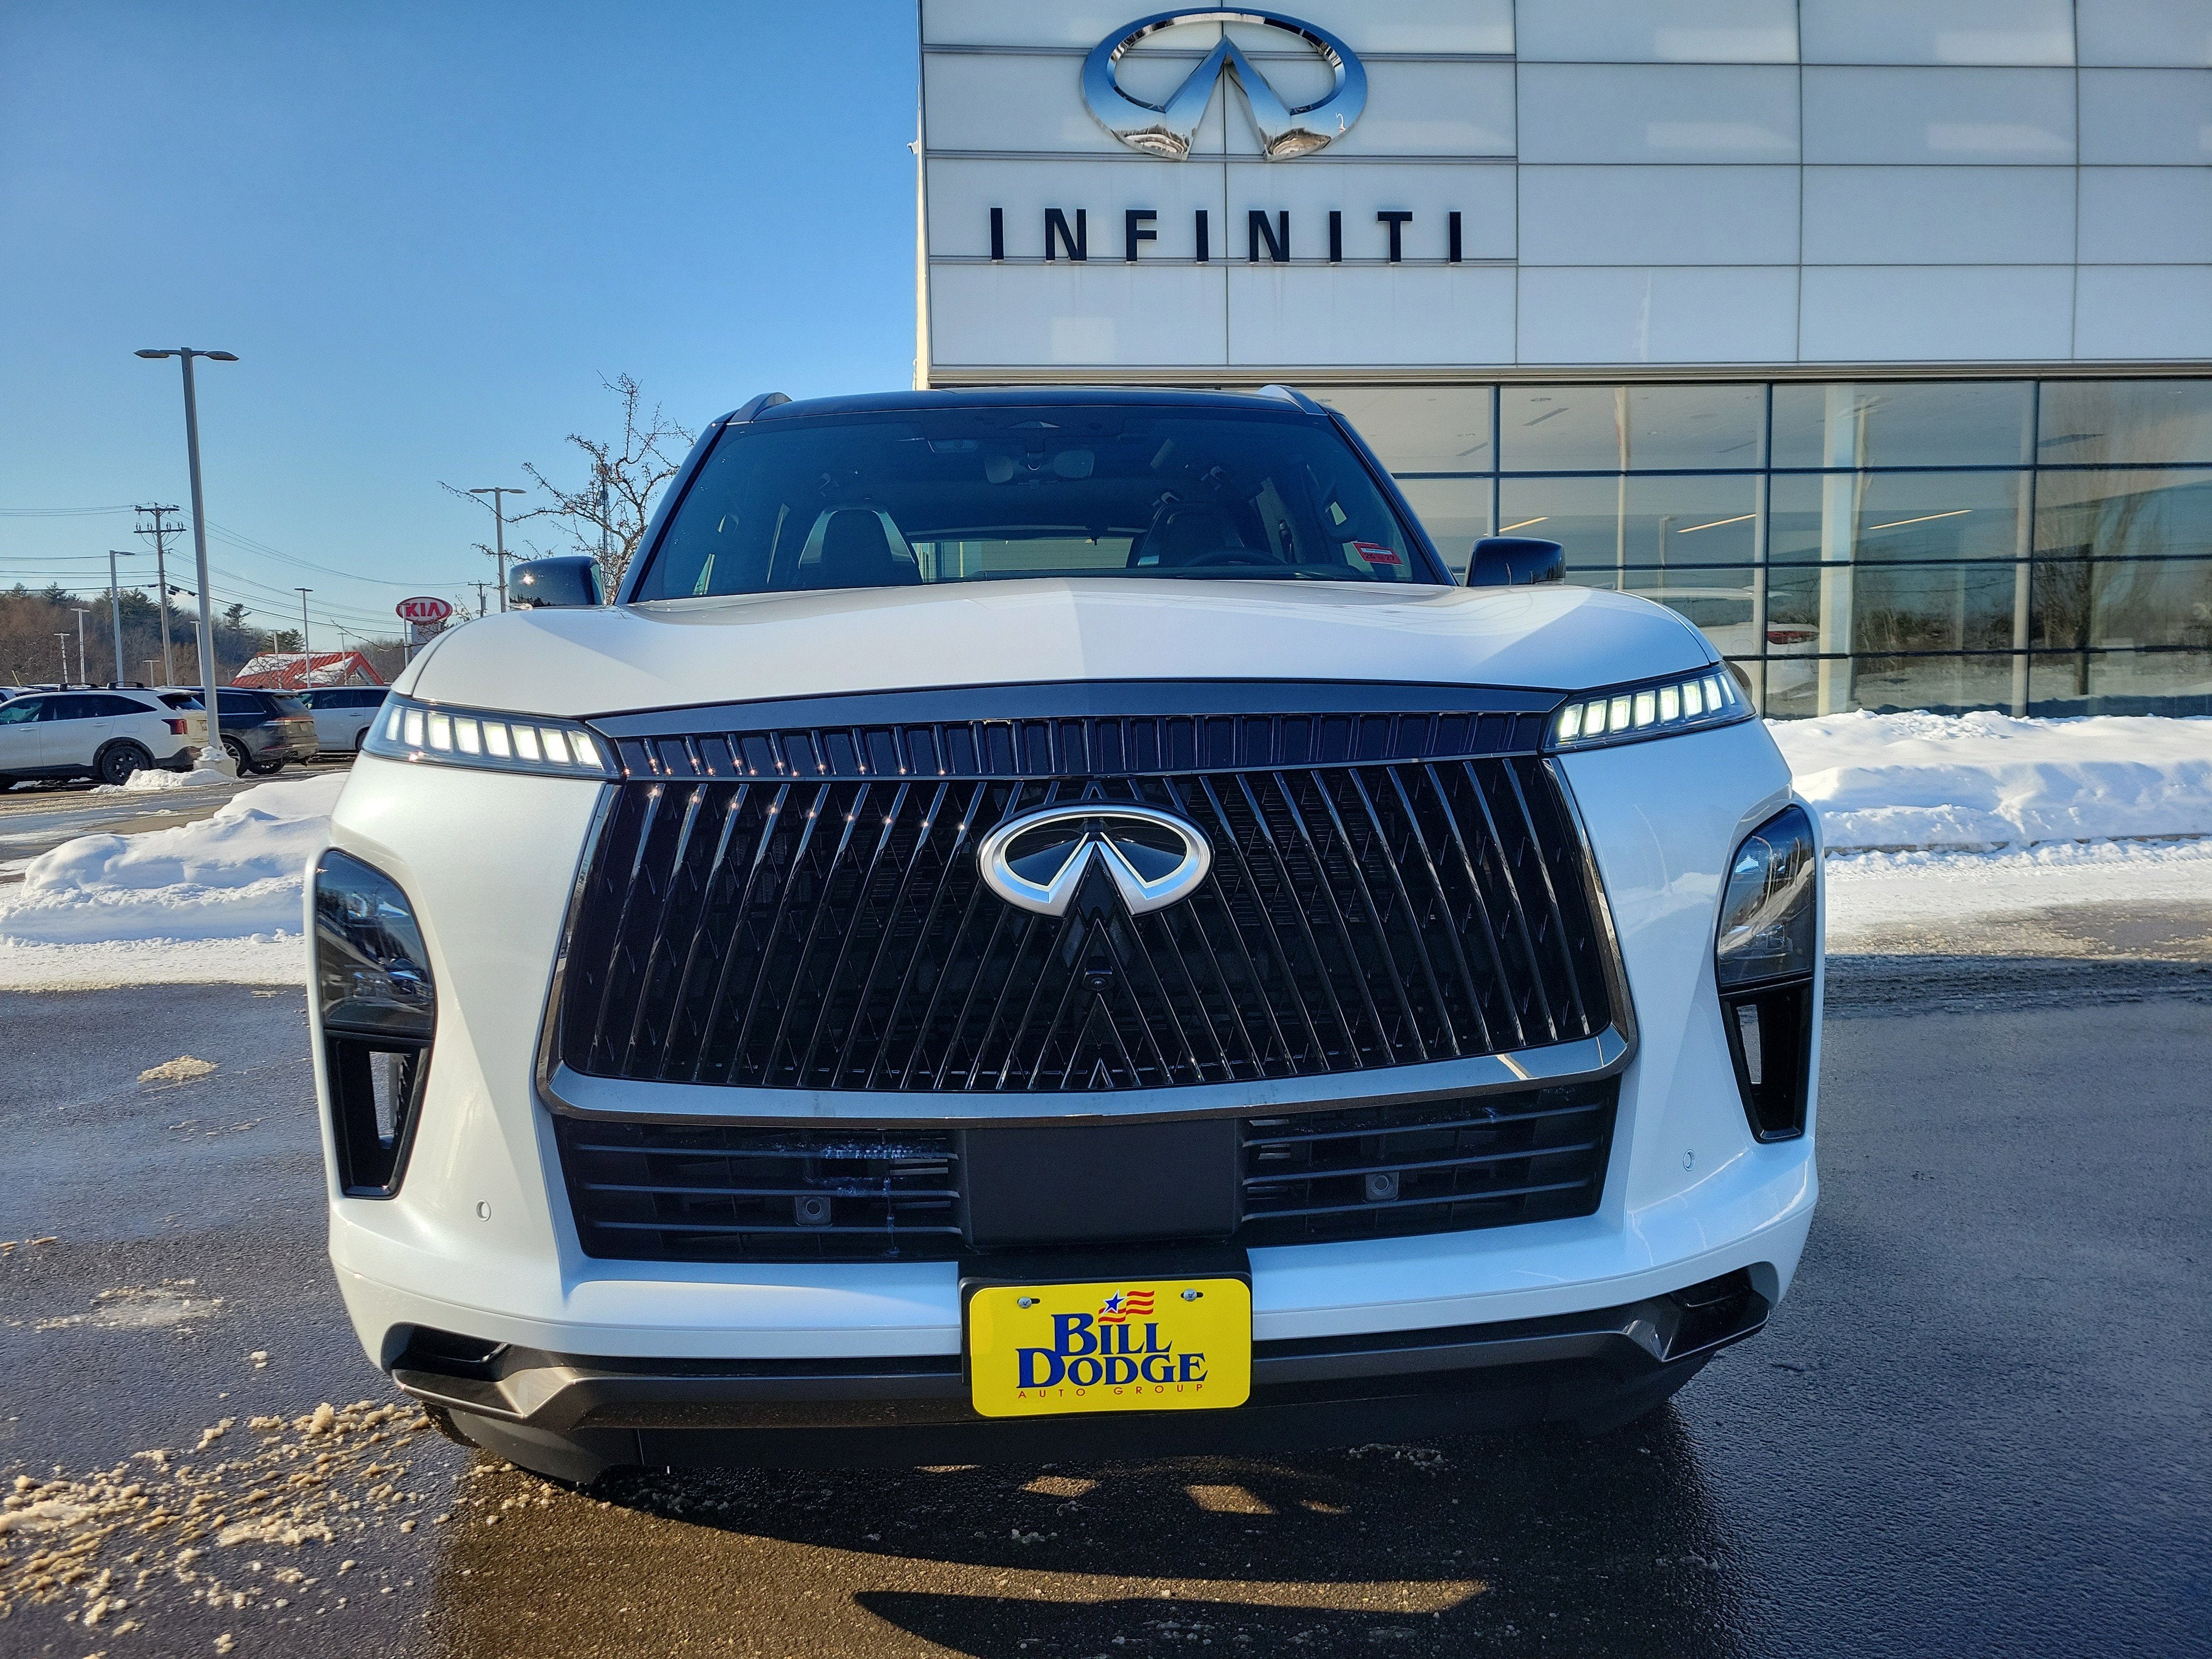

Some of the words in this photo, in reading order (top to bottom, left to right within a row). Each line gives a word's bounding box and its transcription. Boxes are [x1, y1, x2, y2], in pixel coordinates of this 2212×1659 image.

[990, 207, 1462, 263] INFINITI
[405, 602, 442, 617] KIA
[1051, 1313, 1172, 1356] BILL
[1015, 1348, 1208, 1389] DODGE
[1018, 1388, 1086, 1399] AUTO
[1113, 1384, 1204, 1396] GROUP
